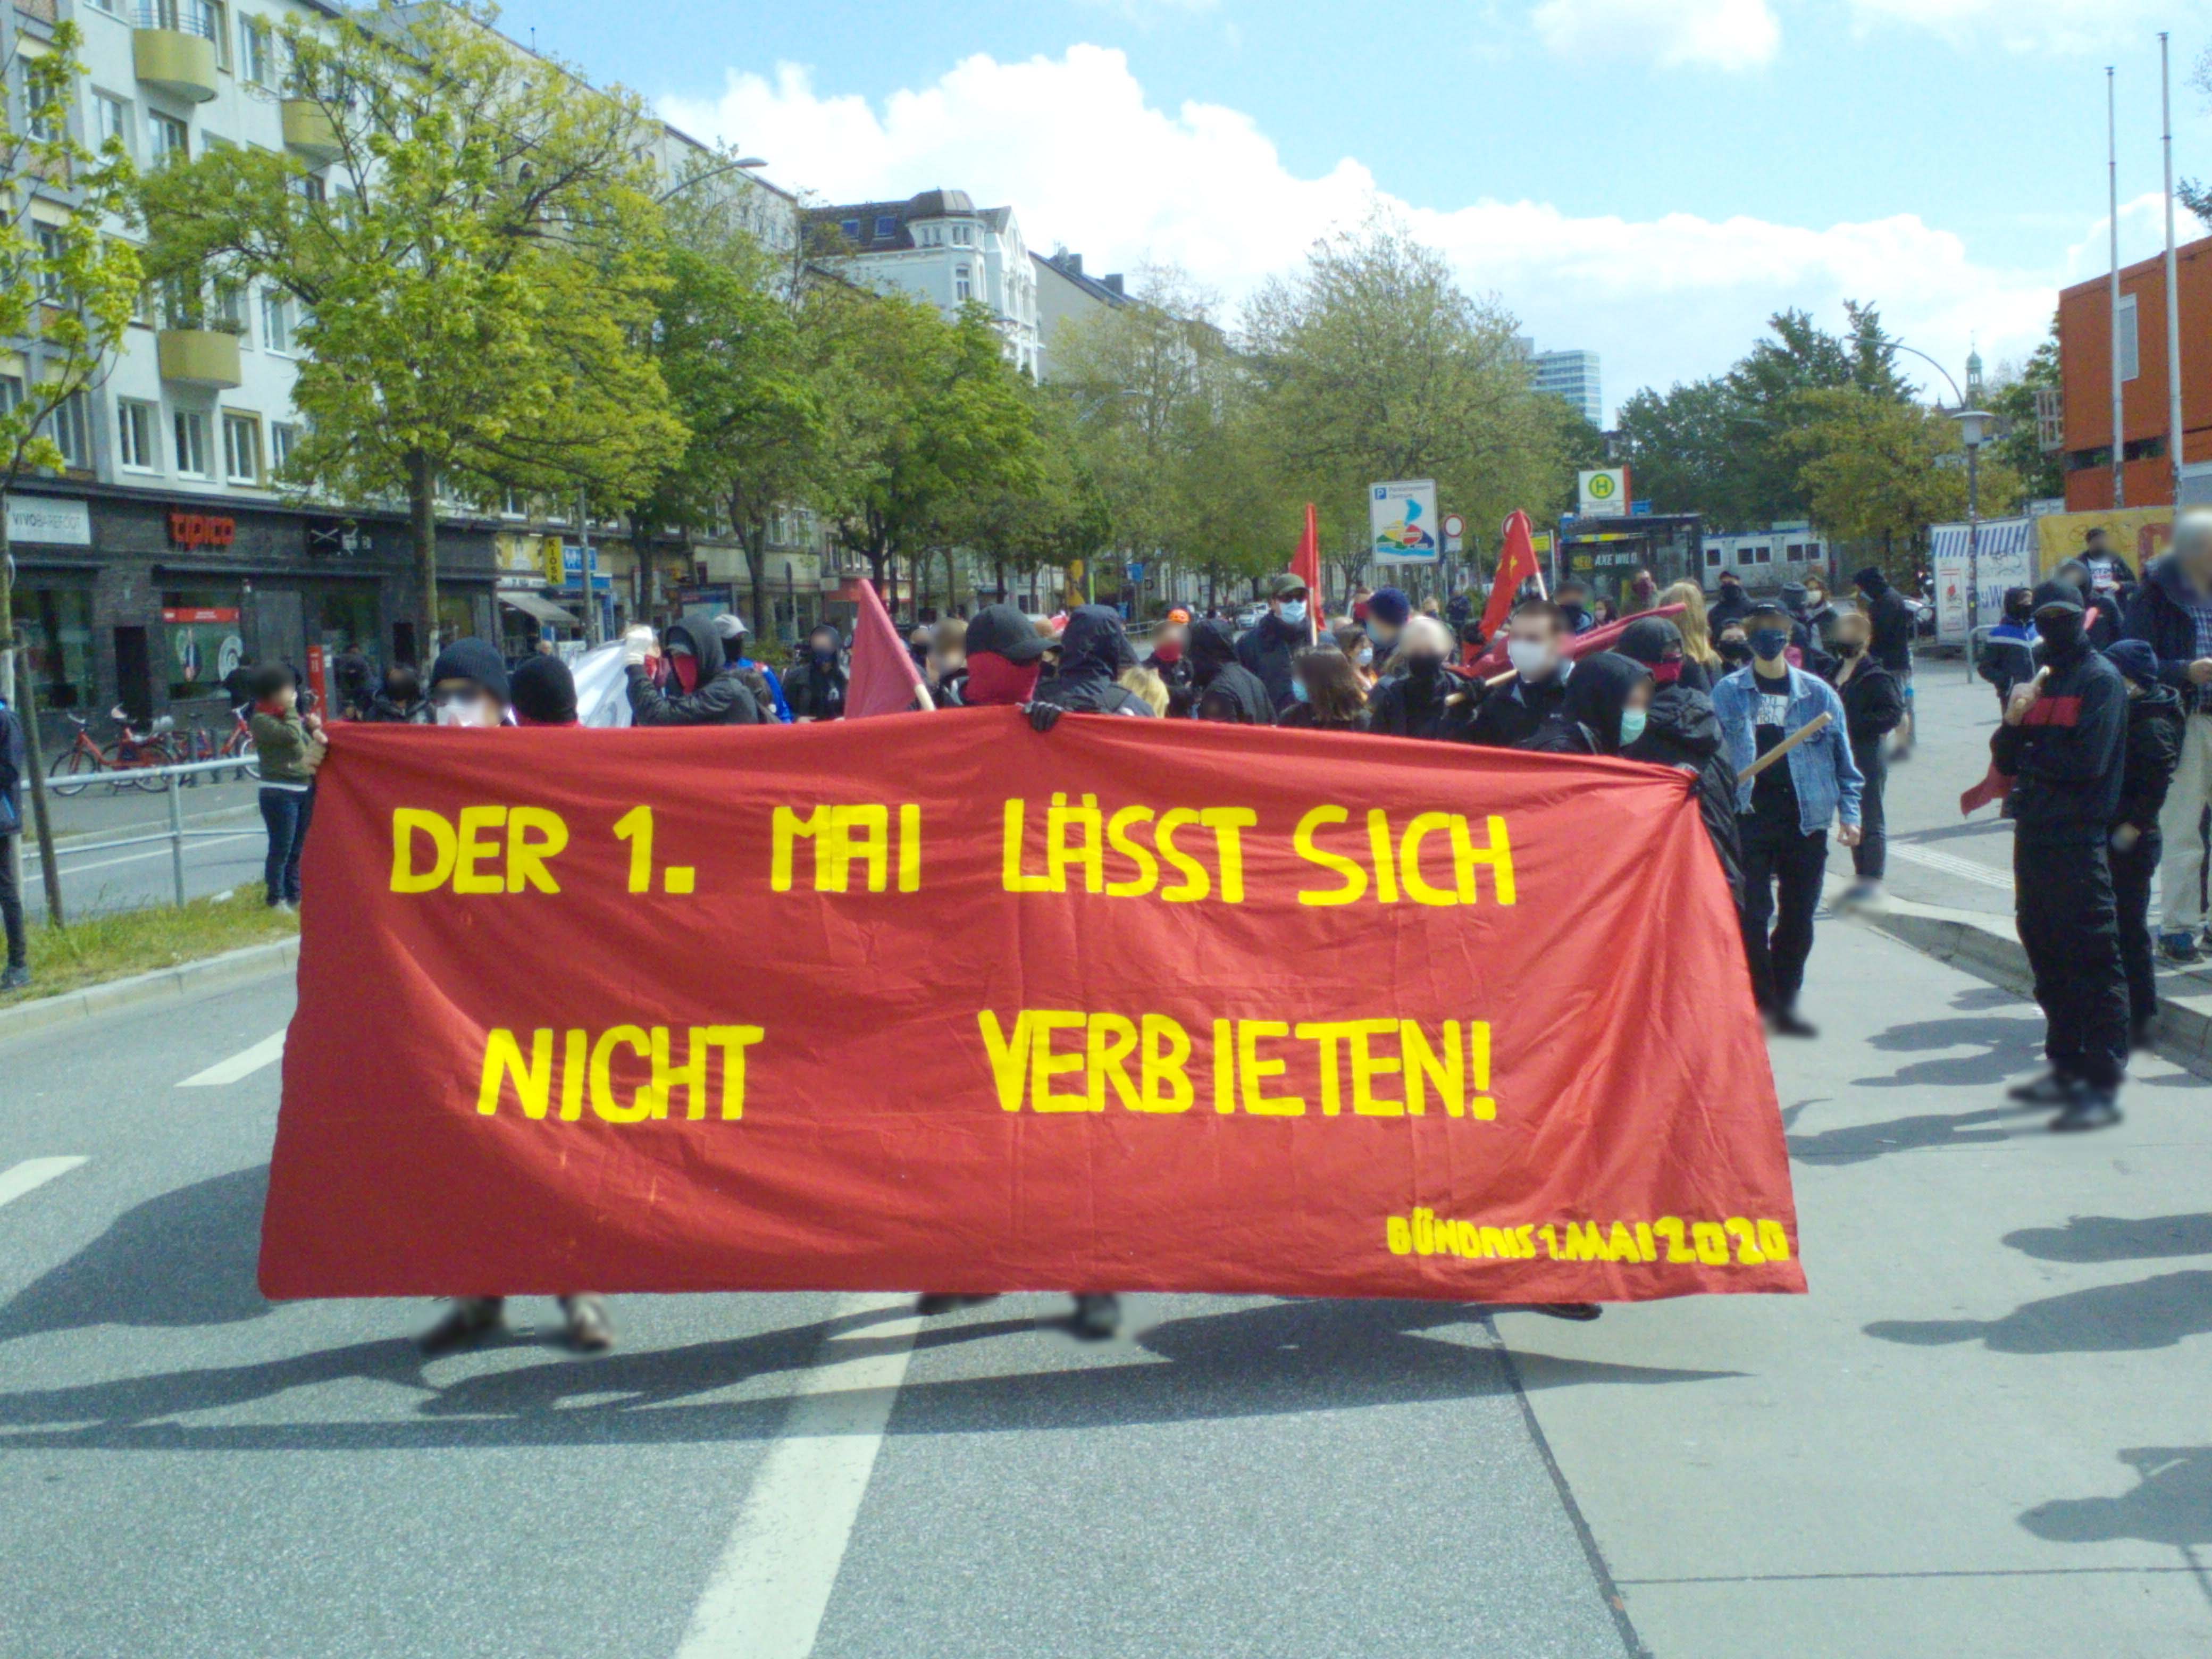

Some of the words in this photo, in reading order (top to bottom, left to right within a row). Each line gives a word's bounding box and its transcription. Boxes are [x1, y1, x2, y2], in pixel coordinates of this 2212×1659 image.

[548, 539, 559, 583] KIOSK
[390, 805, 568, 894] DER
[613, 805, 695, 894] 1.
[771, 804, 920, 892] MAI
[1002, 792, 1257, 903] LÄSST
[1293, 804, 1516, 906] SICH
[476, 1024, 765, 1124] NICHT
[977, 1009, 1497, 1120] VERBIETEN!
[1386, 1206, 1536, 1259] BÜNDNIS
